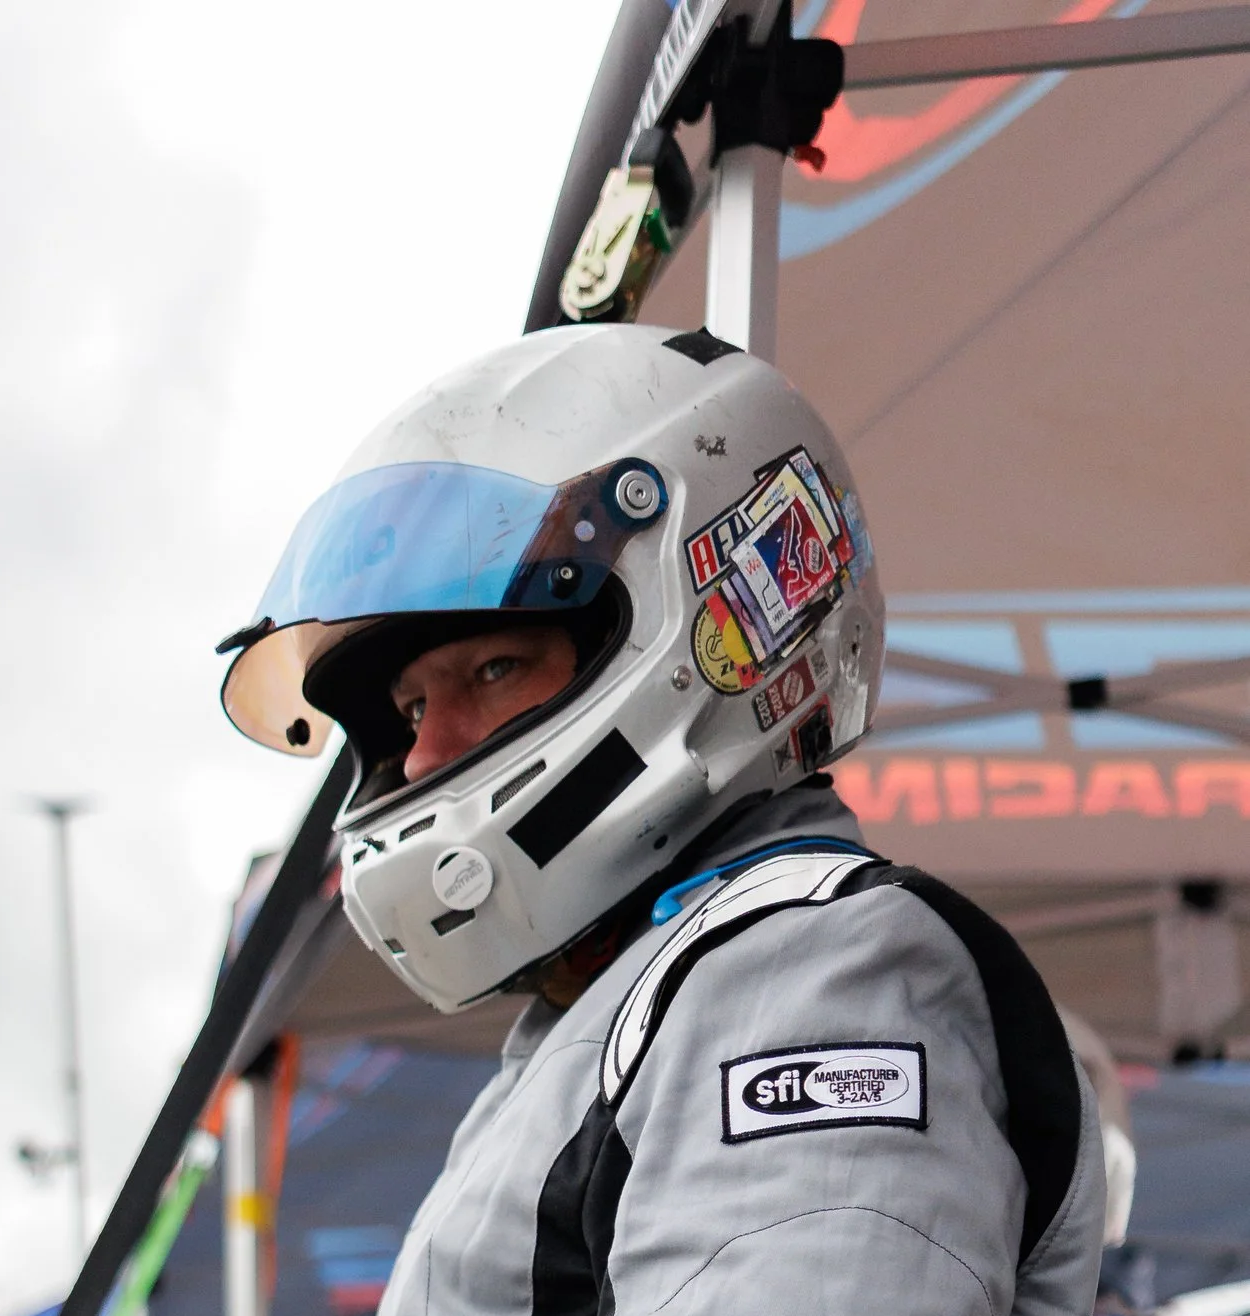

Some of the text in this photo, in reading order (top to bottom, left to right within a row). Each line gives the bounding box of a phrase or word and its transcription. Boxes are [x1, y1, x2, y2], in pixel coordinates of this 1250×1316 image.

[756, 692, 773, 728] 2023
[768, 684, 786, 720] 2024
[755, 1069, 801, 1106] sfi
[814, 1069, 899, 1084] MANUFACTURER
[829, 1080, 886, 1094] CERTIFIED
[837, 1091, 882, 1105] 3-2A/5
